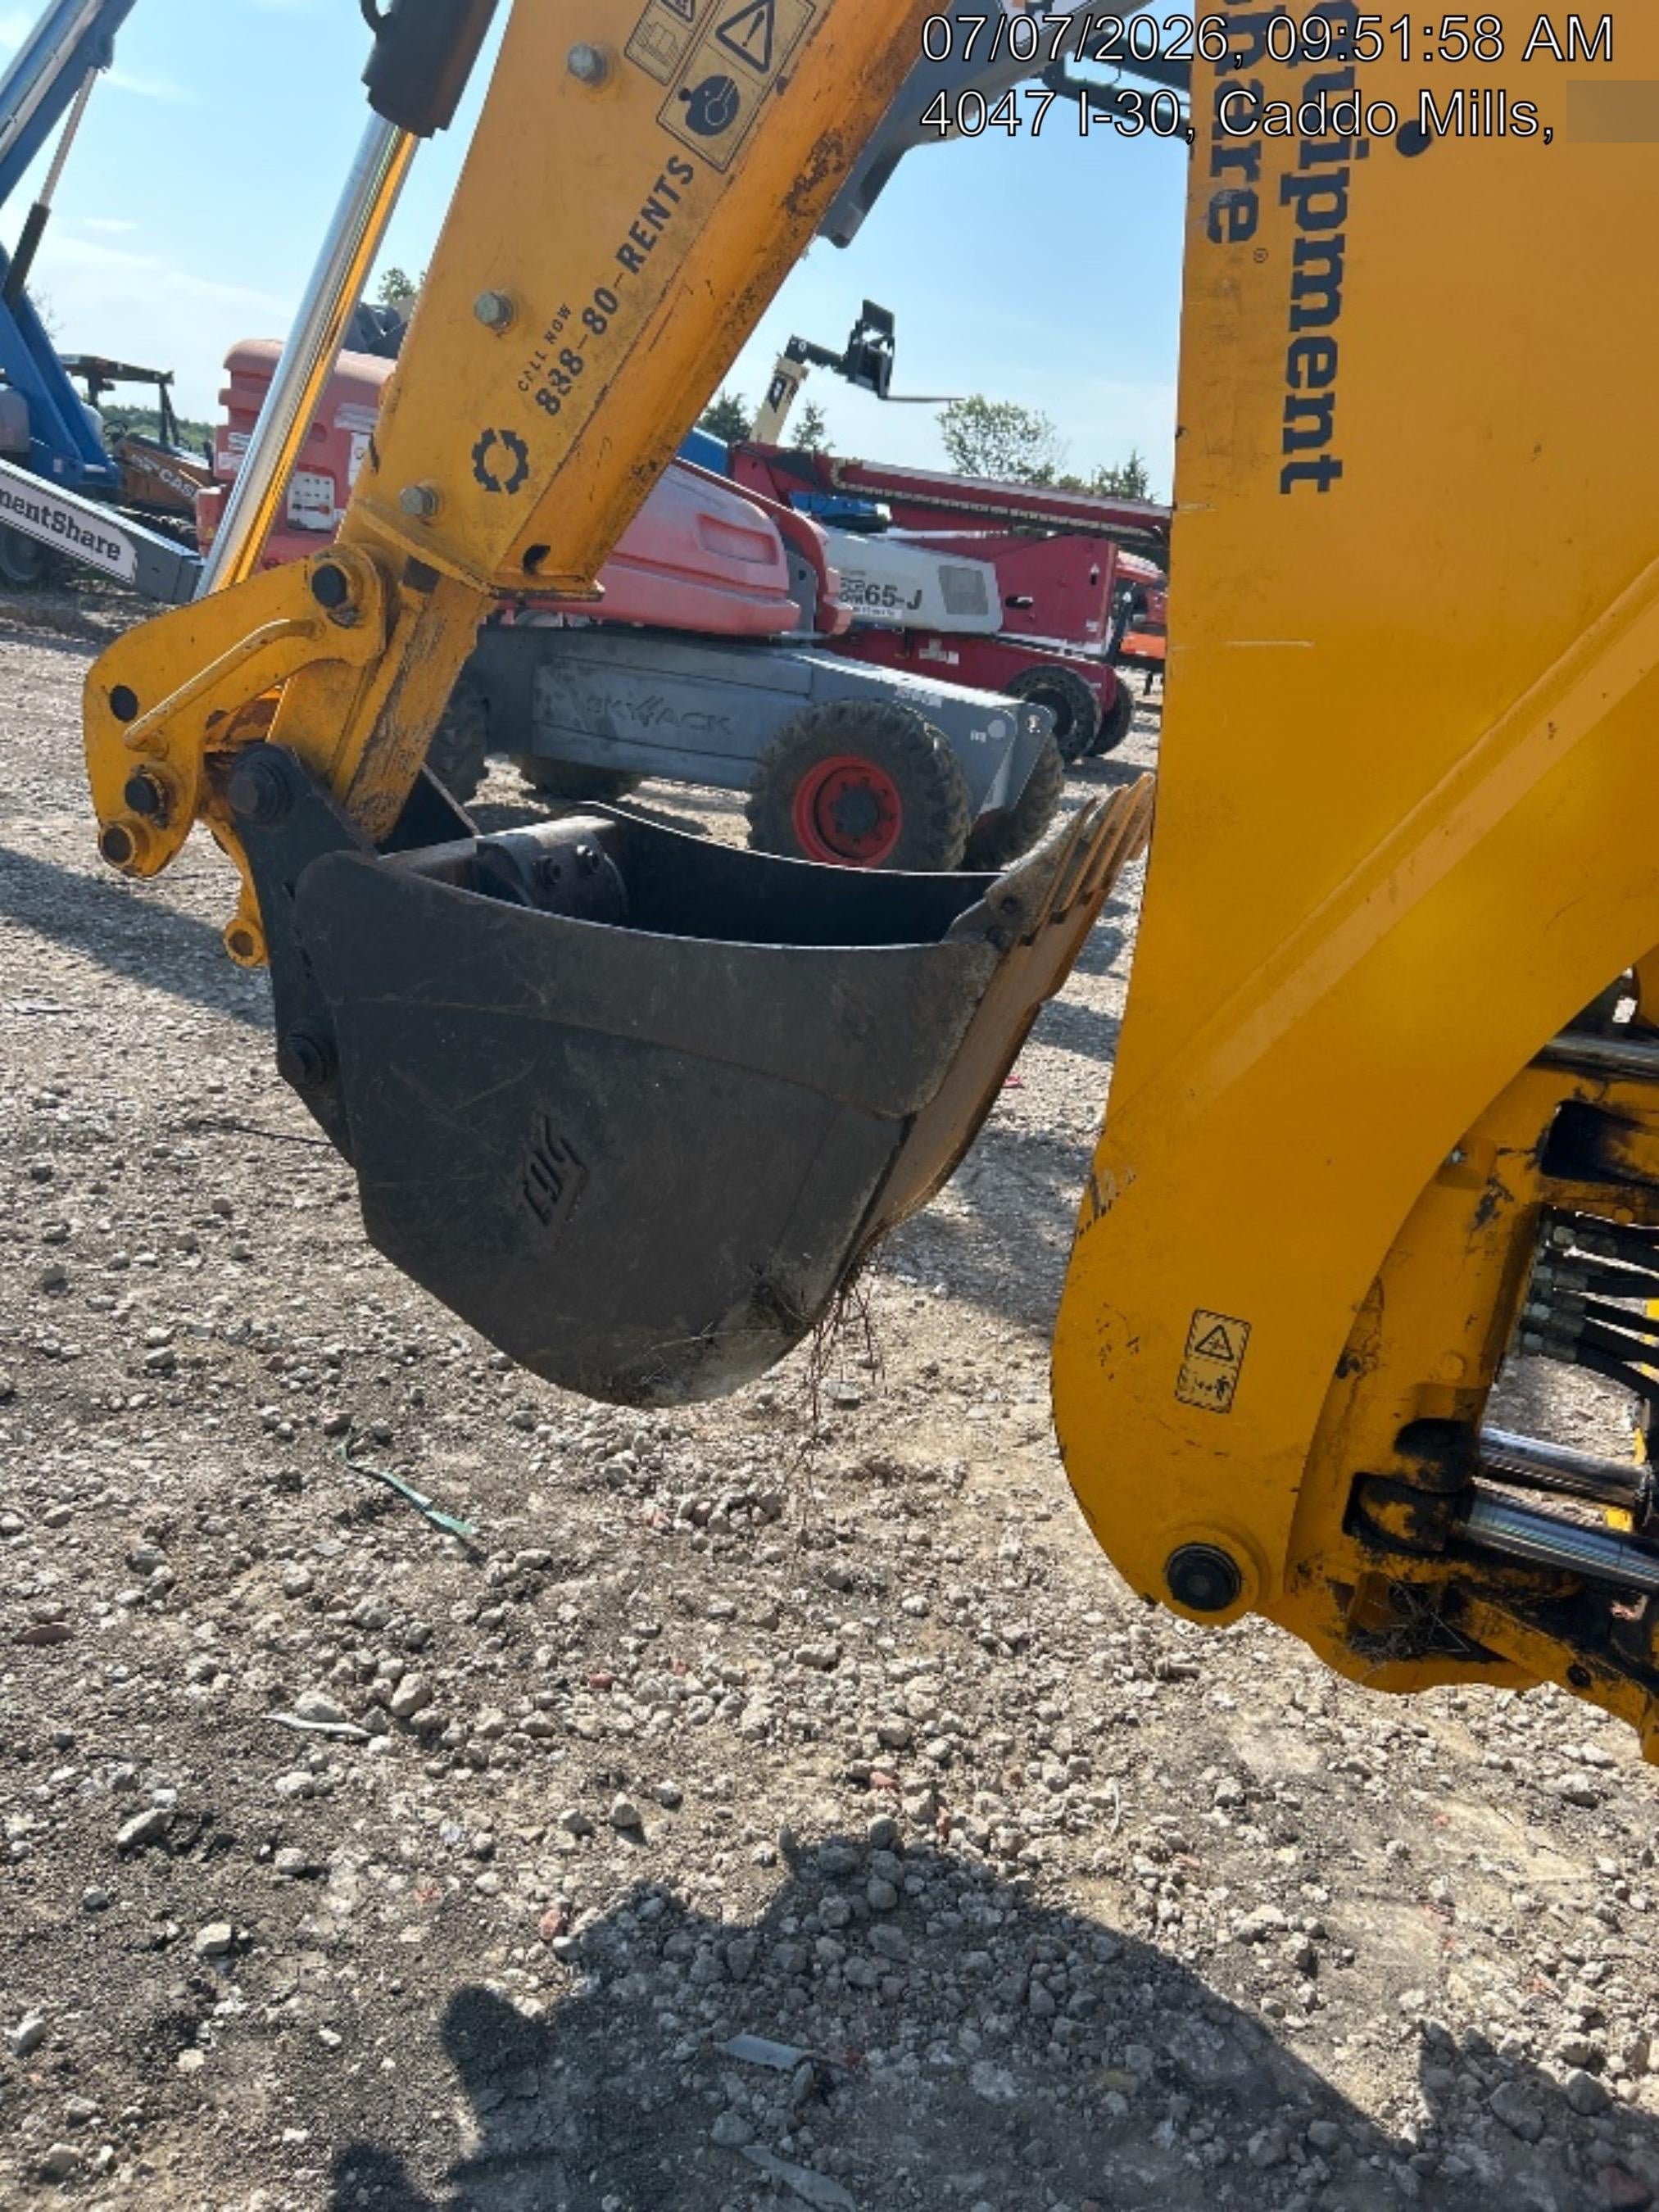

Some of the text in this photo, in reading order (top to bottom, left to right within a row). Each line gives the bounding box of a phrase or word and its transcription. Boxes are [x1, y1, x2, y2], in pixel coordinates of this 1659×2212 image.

[1207, 0, 1285, 243] hare
[518, 302, 572, 392] CALL NOW
